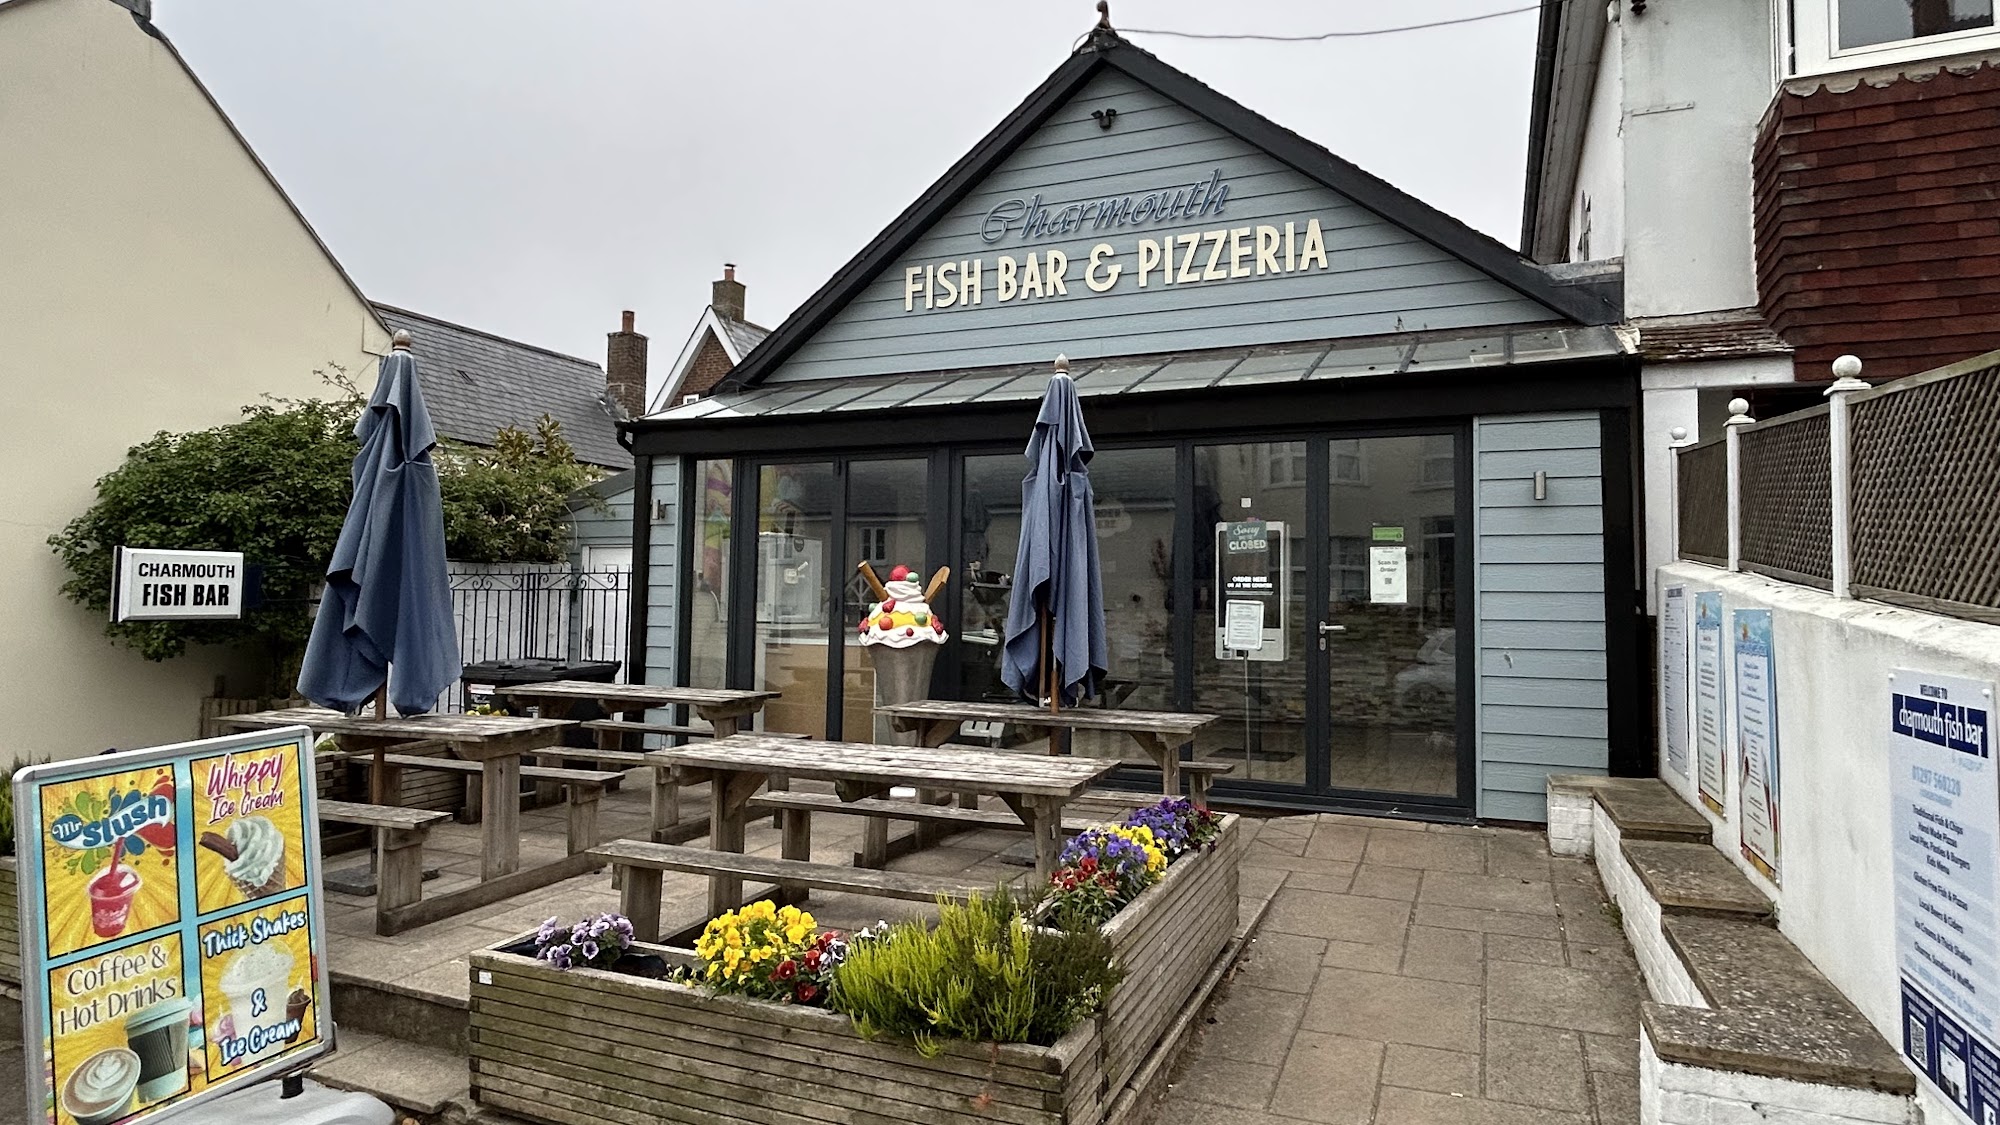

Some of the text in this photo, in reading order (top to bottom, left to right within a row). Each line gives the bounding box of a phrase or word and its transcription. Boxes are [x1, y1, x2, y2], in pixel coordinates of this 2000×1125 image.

[979, 167, 1232, 245] Charmouth
[905, 219, 1328, 311] FISH BAR & PIZZERIA
[1229, 540, 1266, 550] CLOSED
[1233, 525, 1260, 537] Sorry
[138, 563, 235, 578] CHARMOUTH
[142, 584, 229, 606] FISH BAR
[1899, 696, 1983, 756] charmouth fish bar
[208, 753, 283, 795] Whippy
[52, 796, 167, 847] Mr Slush
[209, 791, 283, 824] Ice Cream
[203, 910, 306, 958] Thick Shakes
[68, 945, 166, 995] Coffee &
[61, 978, 176, 1035] Hot Drinks
[252, 988, 267, 1017] &
[219, 1018, 300, 1066] Ice Cream
